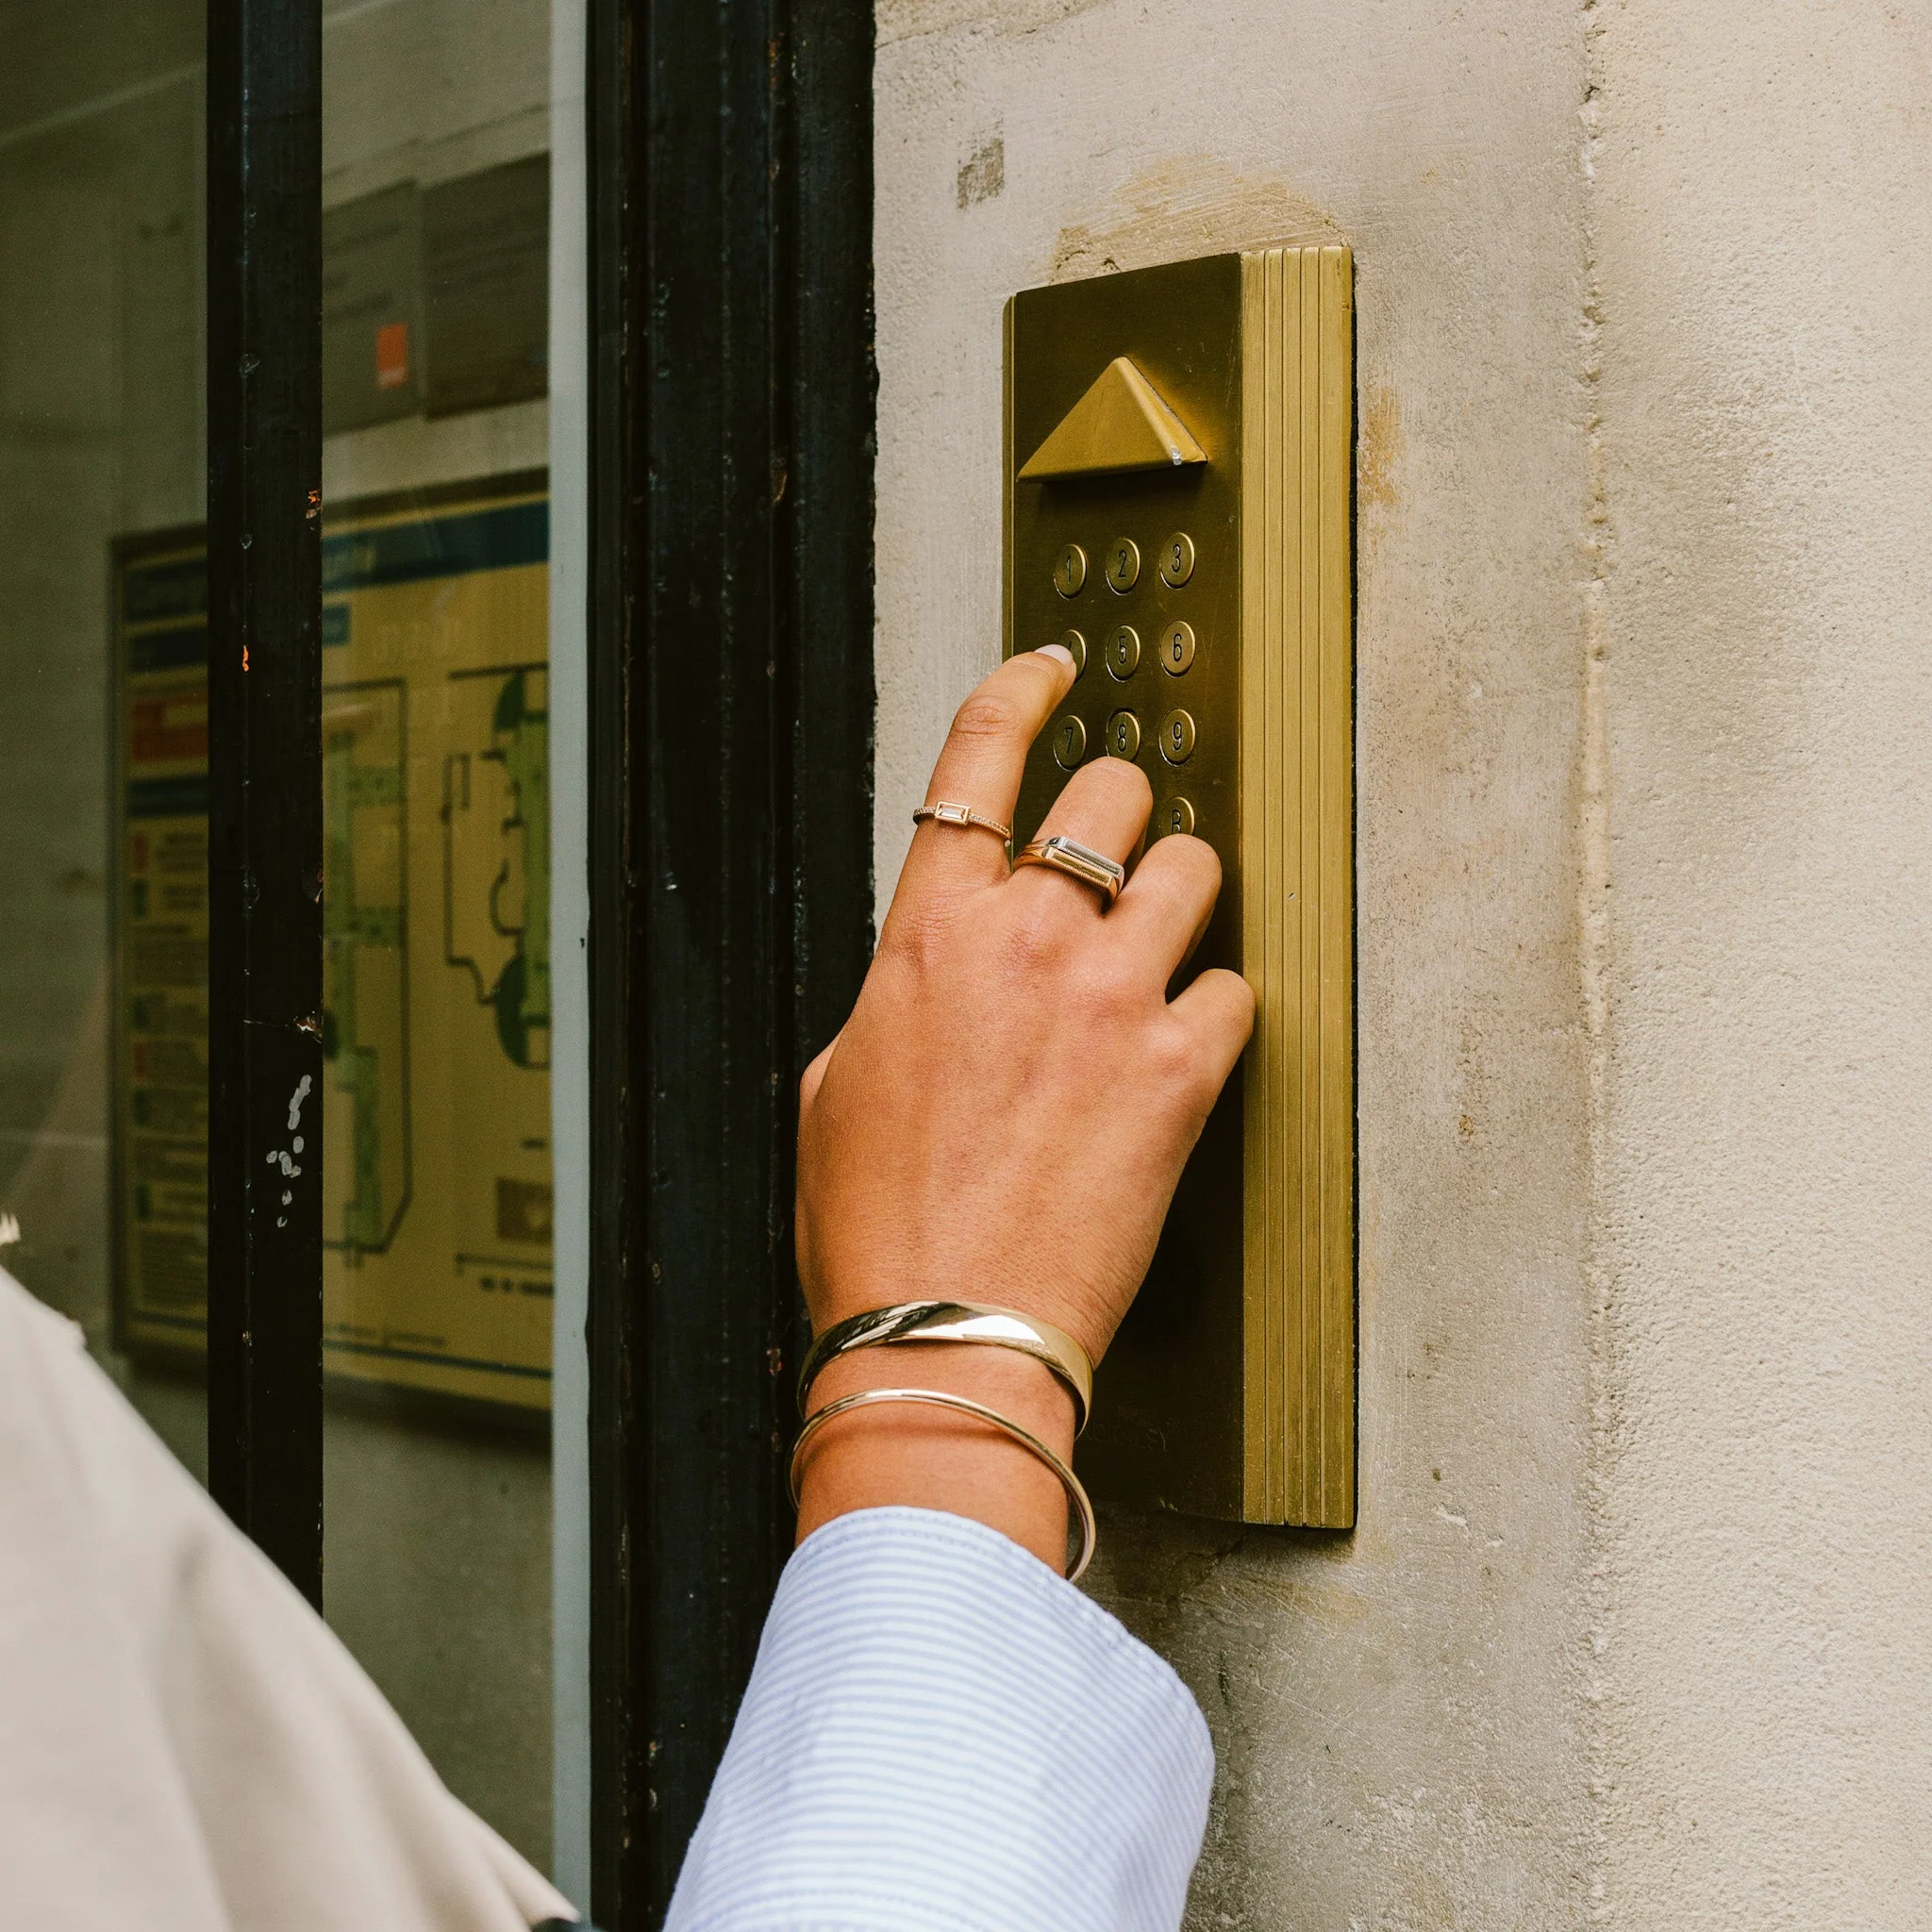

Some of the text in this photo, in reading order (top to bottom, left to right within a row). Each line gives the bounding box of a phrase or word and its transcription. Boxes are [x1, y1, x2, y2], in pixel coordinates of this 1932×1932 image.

[1118, 549, 1127, 578] 2
[1172, 543, 1181, 573] 3
[1118, 633, 1182, 664] 5 6
[1064, 722, 1182, 754] 7 8 9
